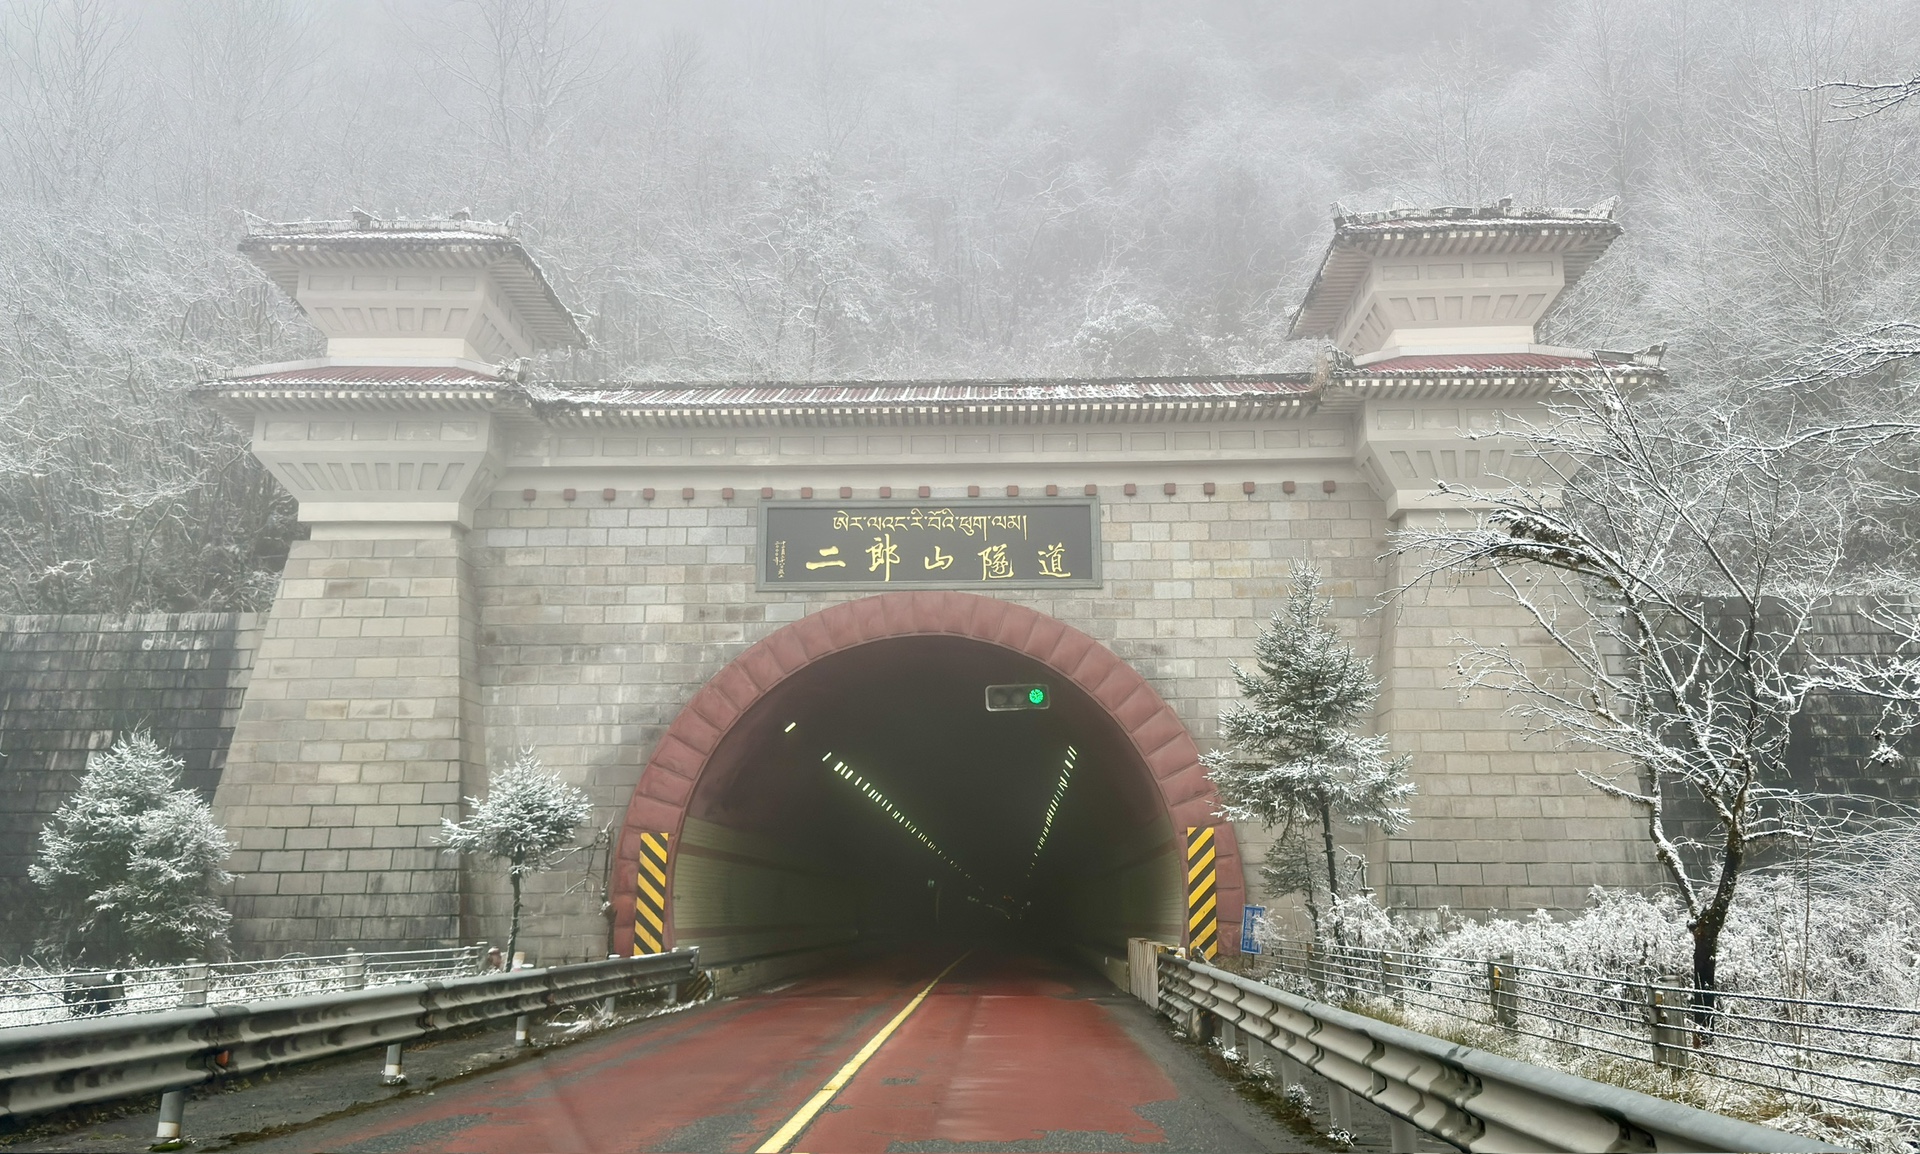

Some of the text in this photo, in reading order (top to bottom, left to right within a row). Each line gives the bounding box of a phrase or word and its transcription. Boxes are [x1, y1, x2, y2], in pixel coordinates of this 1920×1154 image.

[806, 533, 1072, 582] 二郎山隧道
